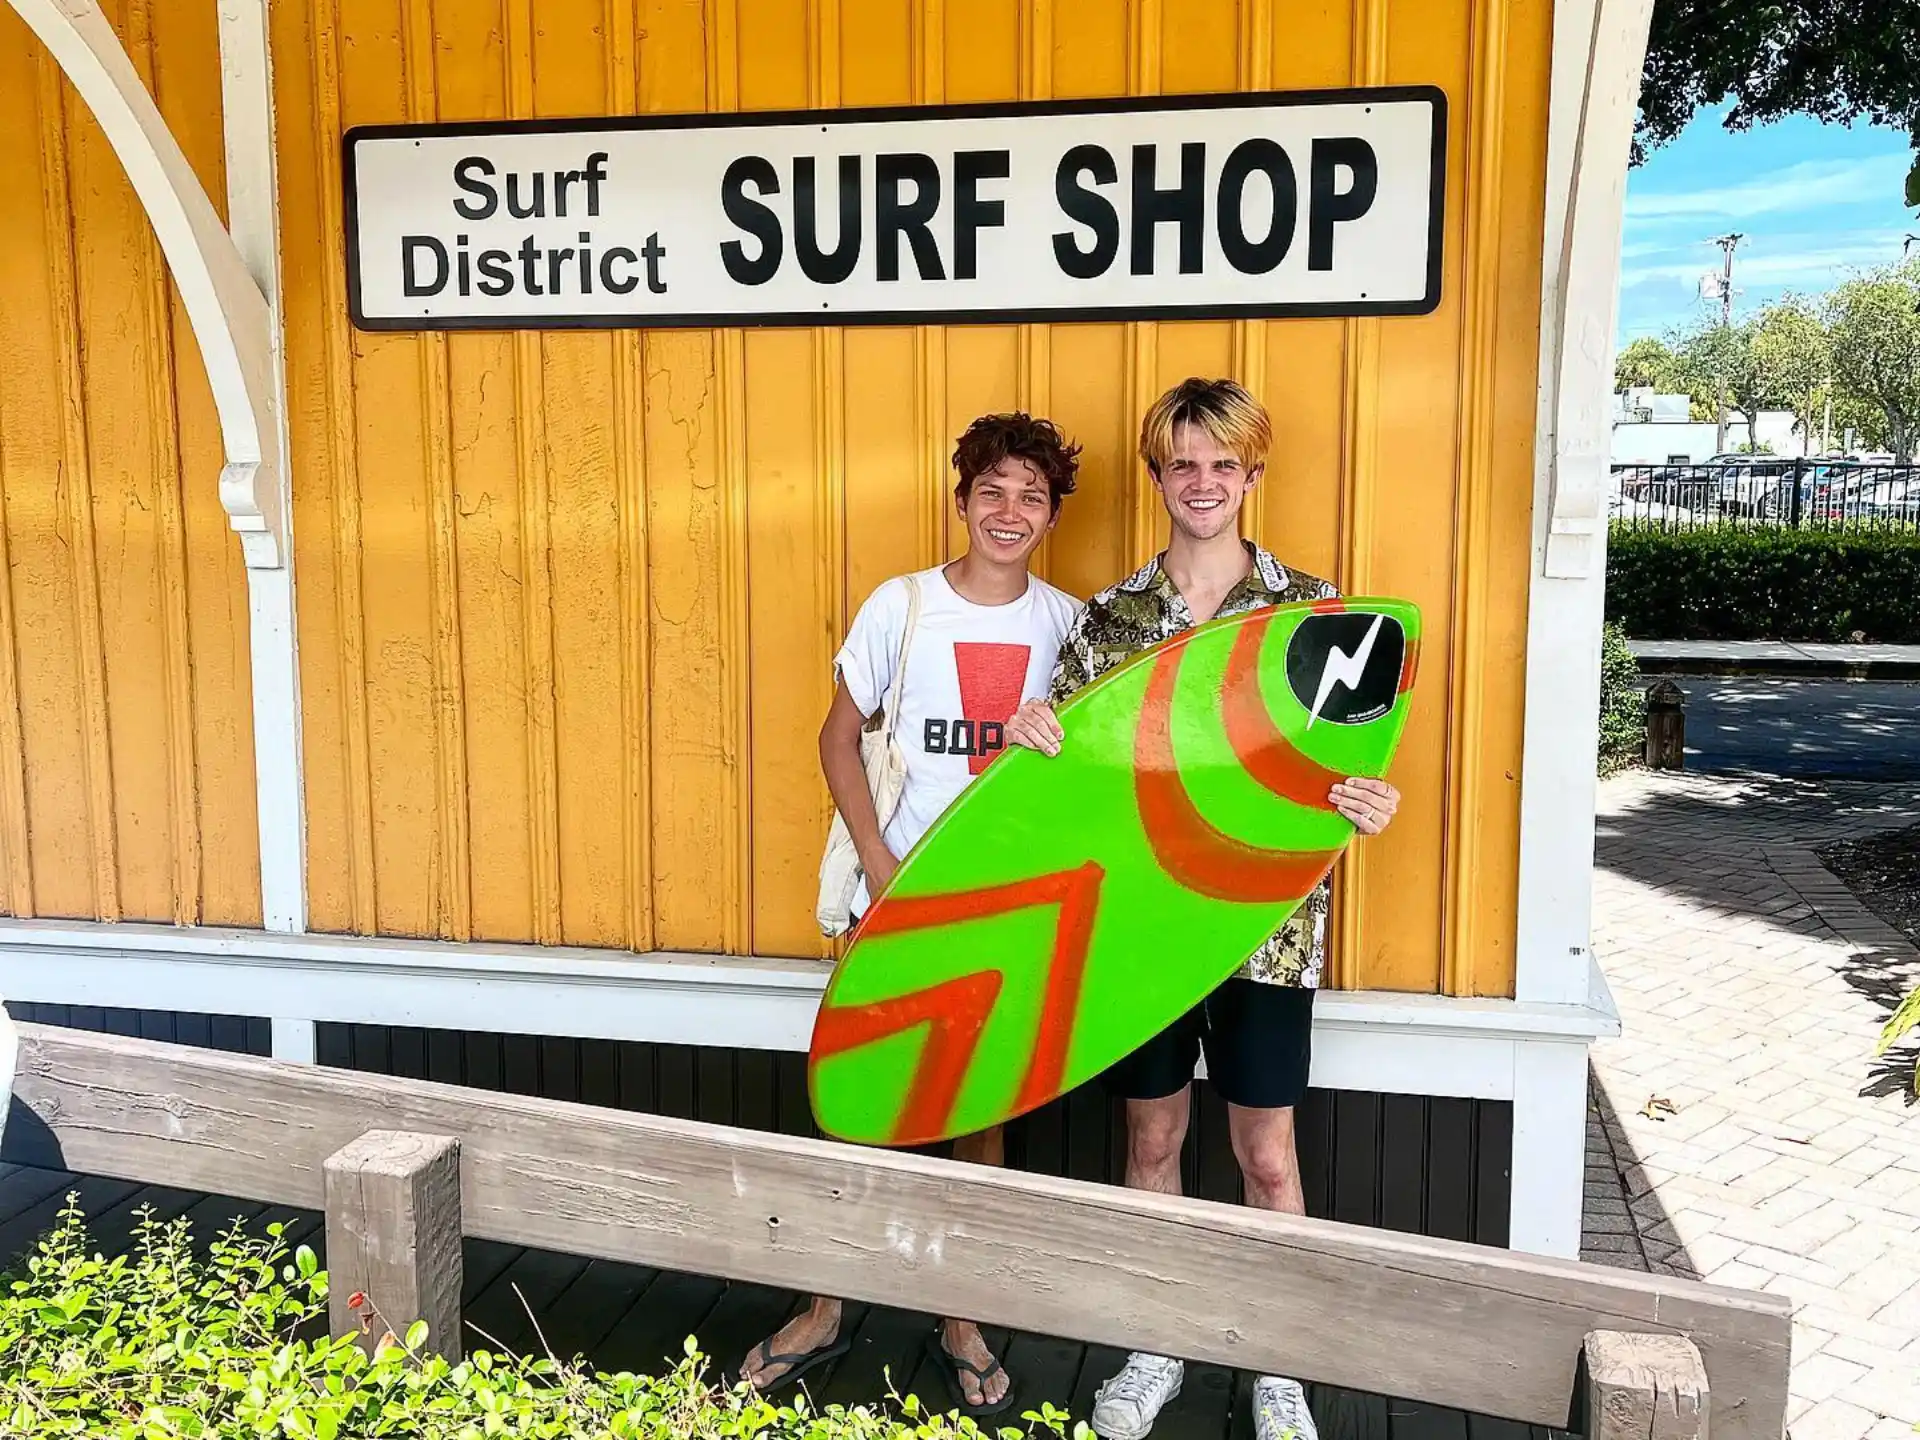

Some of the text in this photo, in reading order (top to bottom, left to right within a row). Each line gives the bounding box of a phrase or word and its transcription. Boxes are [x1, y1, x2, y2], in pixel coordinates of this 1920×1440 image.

[453, 152, 608, 220] Surf
[720, 137, 1377, 285] SURF SHOP
[402, 231, 667, 297] District
[1126, 627, 1177, 643] VEGA
[924, 718, 1004, 757] ВДР
